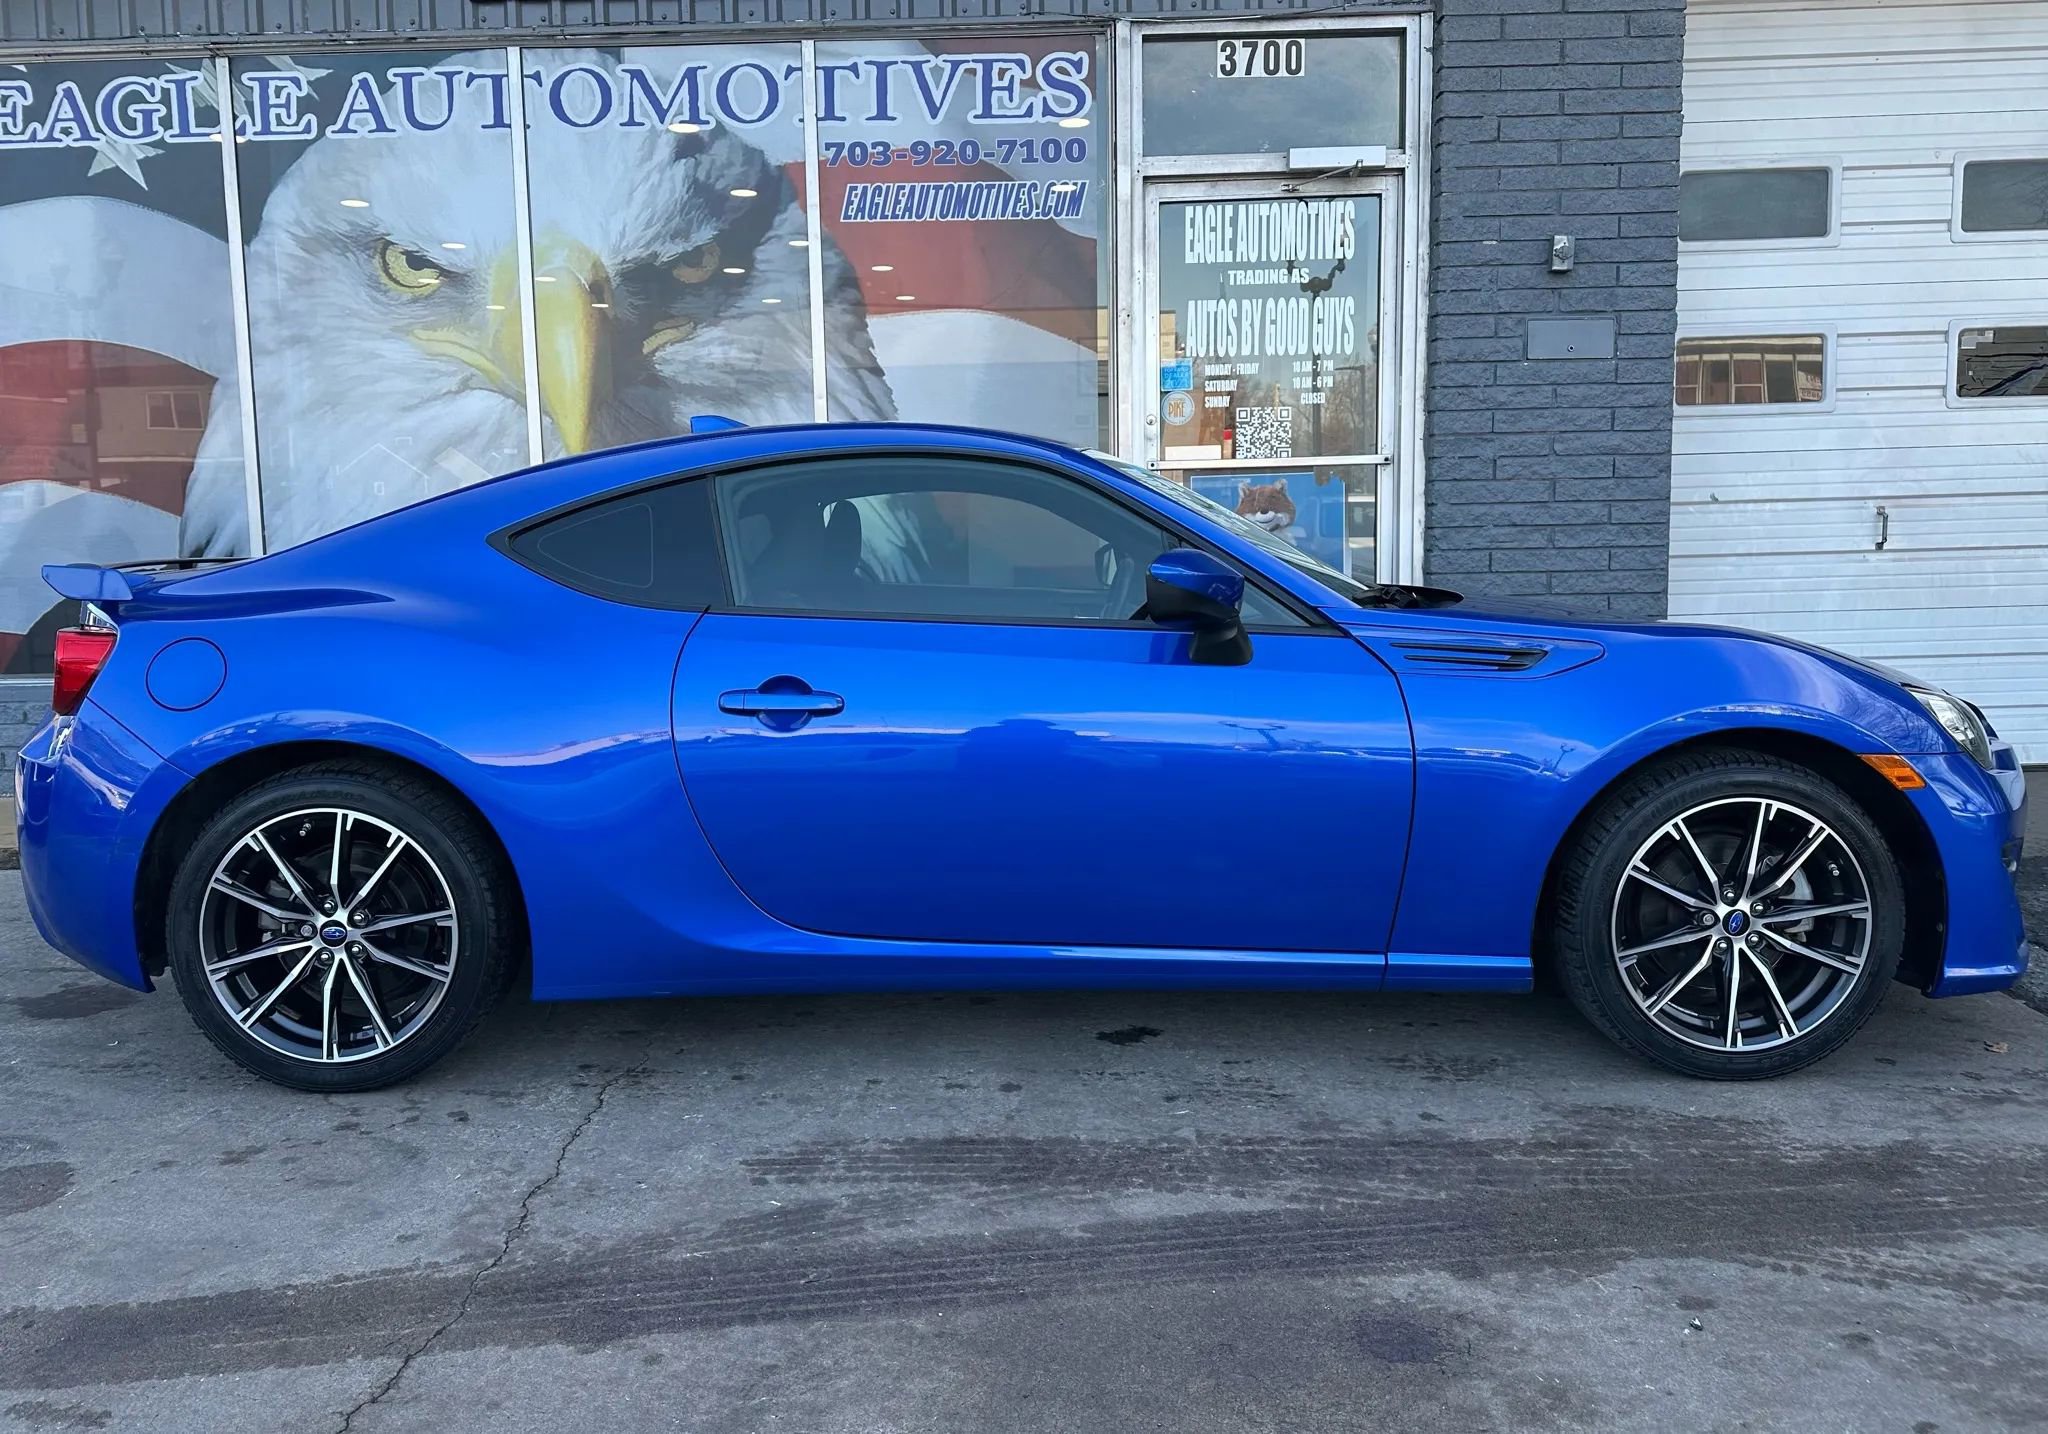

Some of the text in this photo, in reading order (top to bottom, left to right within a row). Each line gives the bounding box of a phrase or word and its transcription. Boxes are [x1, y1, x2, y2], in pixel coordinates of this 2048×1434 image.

[1219, 39, 1303, 77] 3700
[0, 53, 1090, 146] EAGLE AUTOMOTIVES
[824, 138, 1088, 167] 703-920-7100
[841, 181, 1089, 222] EAGLEAUTOMOTIVES.COM
[1185, 200, 1355, 264] EAGLE AUTOMOTIVES
[1228, 268, 1310, 285] TRADING AS
[1186, 296, 1355, 357] AUTOS BY GOOD GUYS
[1205, 364, 1232, 376] MONDAY
[1237, 363, 1259, 375] FRIDAY
[1293, 361, 1300, 372] 10
[1301, 361, 1312, 372] AM
[1323, 360, 1333, 371] PM
[1205, 380, 1237, 392] SATURDAY
[1293, 377, 1300, 388] 10
[1301, 377, 1312, 388] AM
[1323, 376, 1333, 387] PM
[1205, 396, 1230, 408] SUNDAY
[1301, 393, 1325, 404] CLOSED
